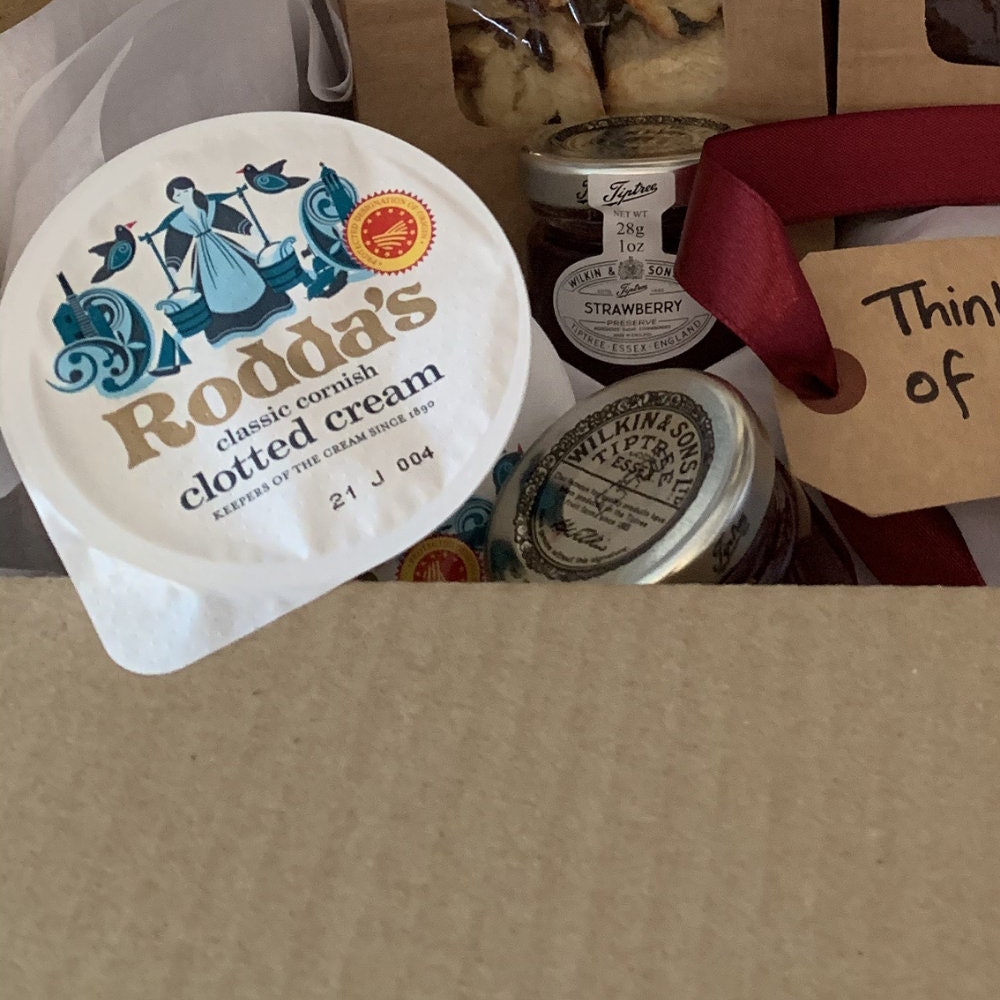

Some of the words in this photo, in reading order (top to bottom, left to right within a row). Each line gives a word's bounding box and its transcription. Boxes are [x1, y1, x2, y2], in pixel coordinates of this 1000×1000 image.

[602, 180, 658, 206] Tiptree
[613, 210, 631, 218] NET
[633, 210, 648, 218] WT
[616, 222, 645, 238] 28g
[620, 239, 645, 253] 1oz
[568, 268, 602, 288] WILKIN
[608, 267, 615, 276] &
[649, 265, 673, 277] SON
[584, 300, 683, 316] STRAWBERRY
[607, 318, 657, 327] PRESERVE
[571, 323, 605, 348] TIPTREE
[612, 343, 646, 353] ESSEX
[654, 319, 702, 349] ENGLAND
[102, 282, 438, 470] Rodda's
[905, 348, 976, 420] of
[216, 401, 292, 452] classic
[296, 363, 380, 410] cornish
[180, 416, 318, 511] clotted
[324, 363, 445, 433] cream
[567, 412, 660, 464] WILKIN
[669, 421, 699, 475] SONS
[212, 482, 270, 521] KEEPERS
[272, 469, 291, 487] OF
[291, 455, 321, 475] THE
[323, 432, 368, 459] CREAM
[369, 415, 406, 438] SINCE
[408, 400, 436, 421] 1890
[329, 484, 357, 511] 21
[371, 469, 385, 488] J
[396, 446, 435, 472] 004
[591, 434, 675, 487] TIPTREE
